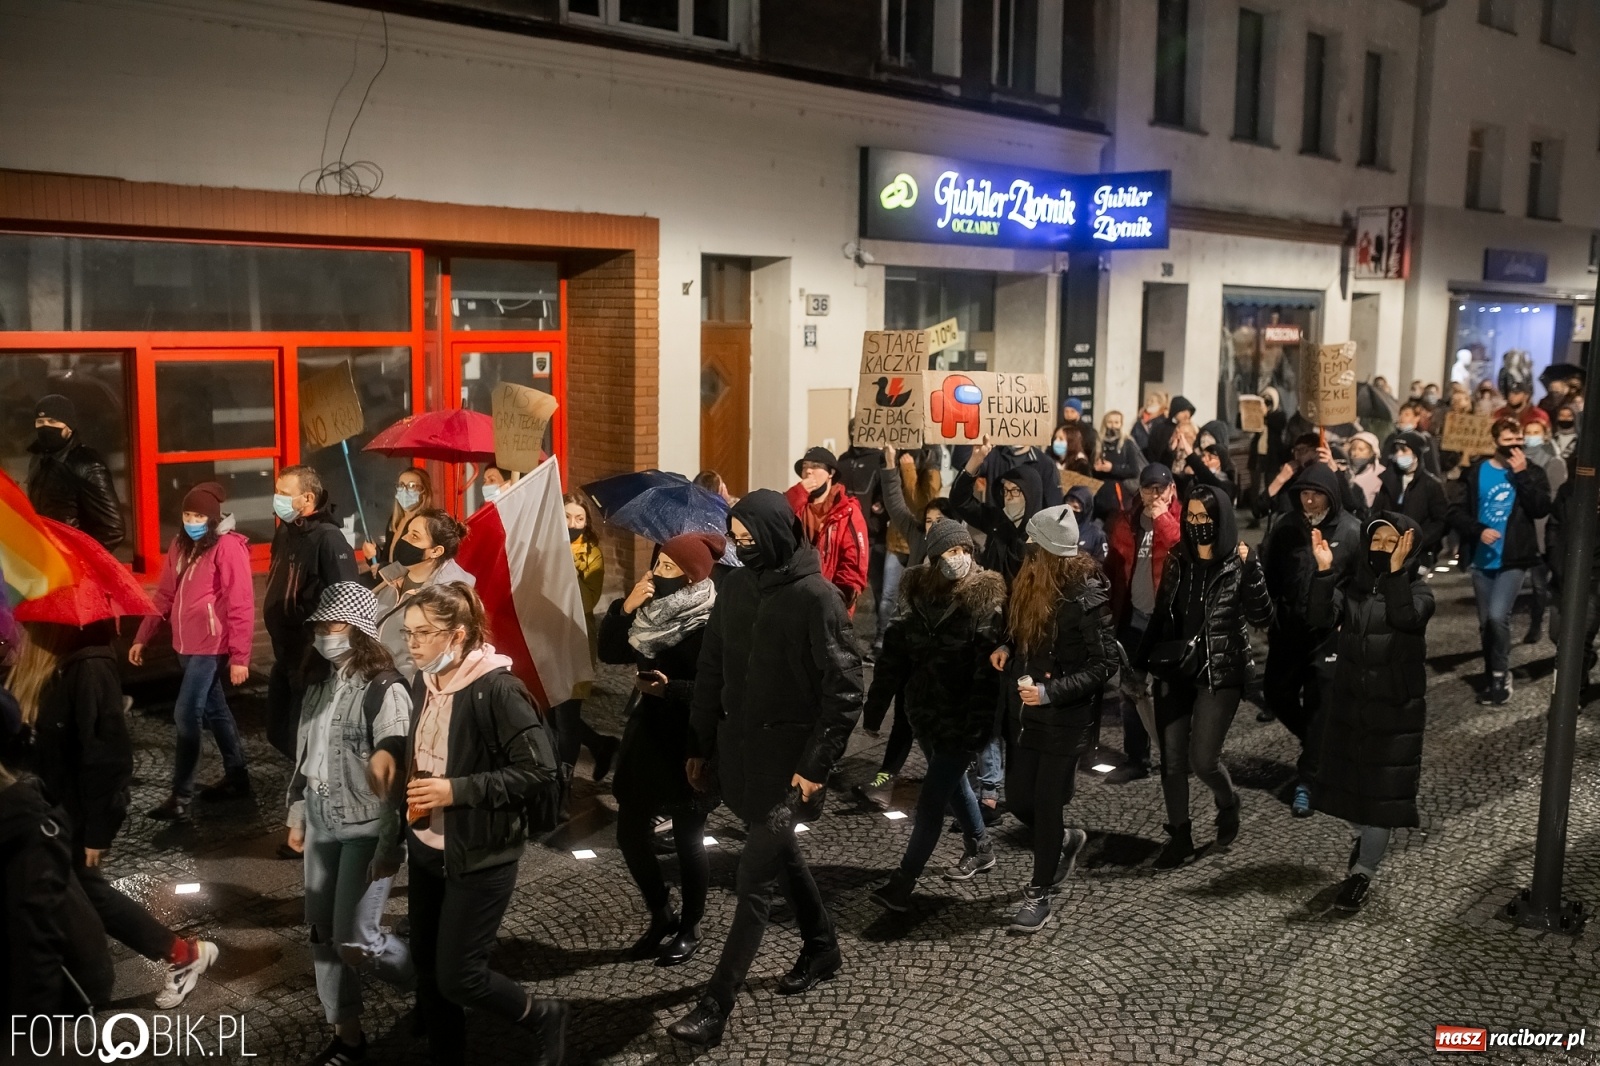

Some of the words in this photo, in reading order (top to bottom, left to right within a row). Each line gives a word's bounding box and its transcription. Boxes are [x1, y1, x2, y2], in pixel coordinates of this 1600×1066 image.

[935, 171, 1009, 228] Jubiler
[1094, 185, 1153, 216] Jubiler
[812, 298, 828, 311] 36
[867, 333, 925, 354] STARE
[865, 354, 920, 373] KACZKI
[996, 373, 1028, 394] PIS
[502, 385, 535, 408] PIS
[987, 395, 1050, 415] FEJKUJE
[861, 402, 916, 426] JEBAĆ
[985, 417, 1038, 438] TASKI
